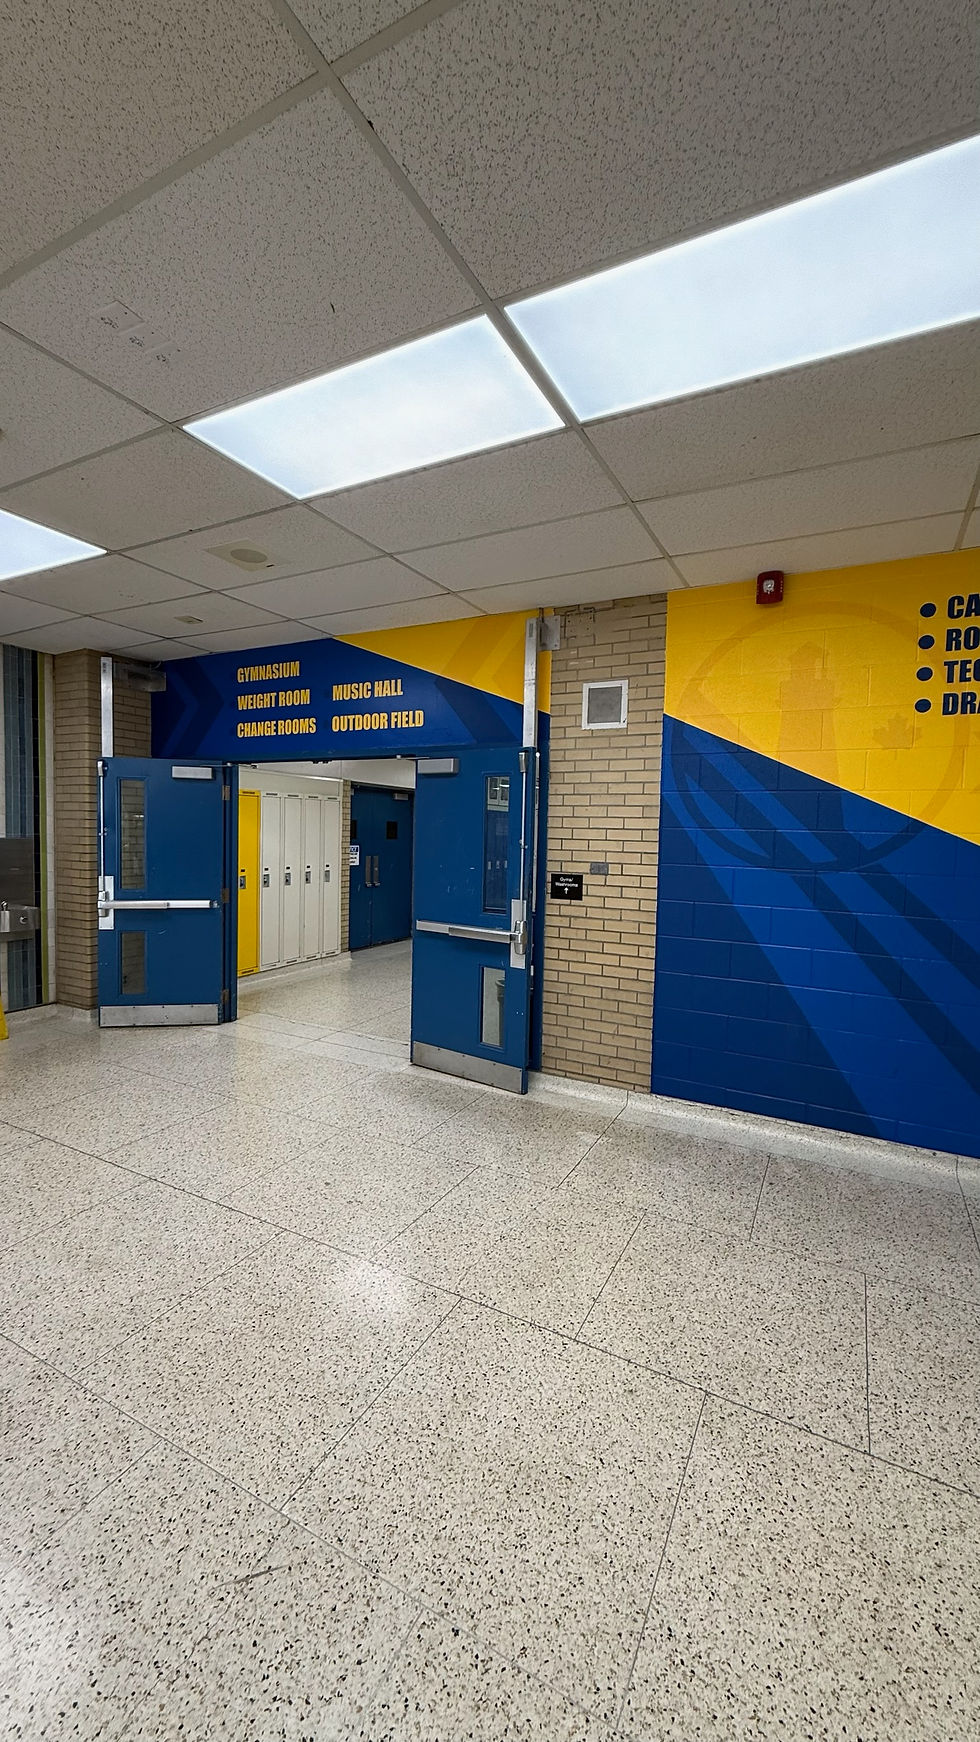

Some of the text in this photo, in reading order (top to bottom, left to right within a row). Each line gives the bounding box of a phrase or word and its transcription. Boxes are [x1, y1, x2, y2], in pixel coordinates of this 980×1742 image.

[237, 661, 300, 683] GYMNASIUM
[237, 689, 310, 711] WEIGHT ROOM
[332, 679, 403, 701] MUSIC HALL
[942, 691, 980, 715] DR
[237, 718, 316, 738] CHANGE ROOMS
[331, 710, 424, 732] OUTDOOR FIELD
